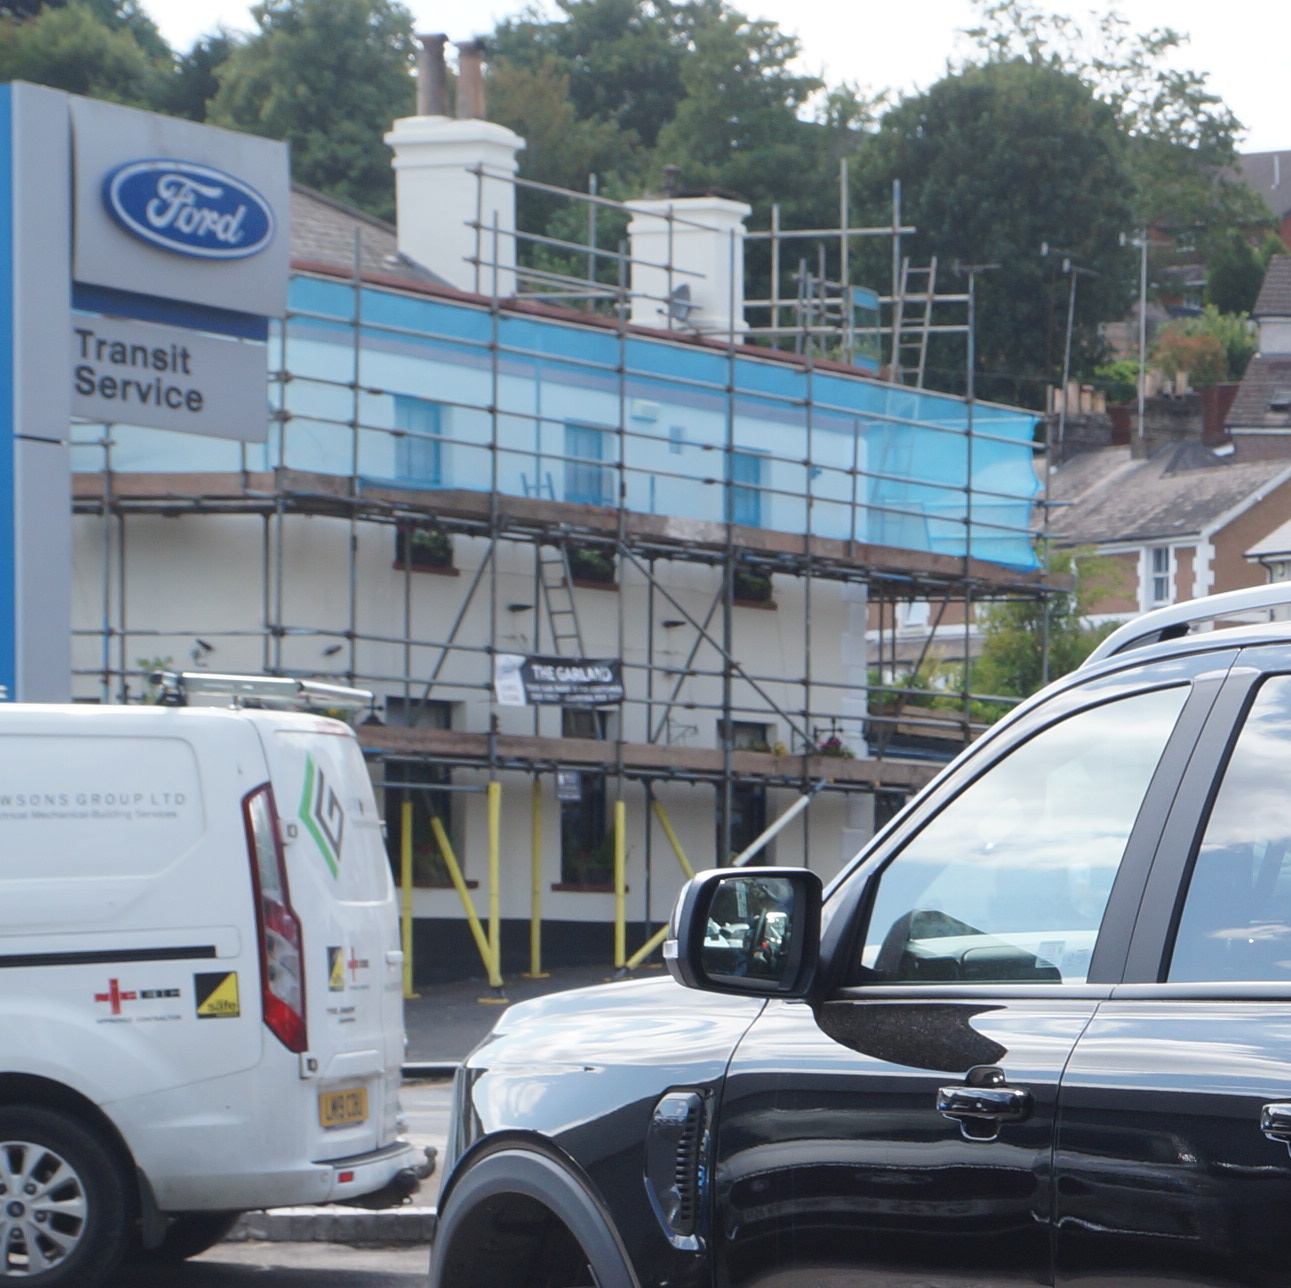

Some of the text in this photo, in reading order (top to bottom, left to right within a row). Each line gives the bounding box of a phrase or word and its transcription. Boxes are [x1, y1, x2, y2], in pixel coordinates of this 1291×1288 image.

[147, 174, 248, 244] Ford
[74, 328, 192, 375] Transit
[74, 364, 204, 412] Service
[531, 664, 613, 682] THE GARLAND
[76, 793, 143, 806] GROUP
[150, 793, 187, 806] LTD
